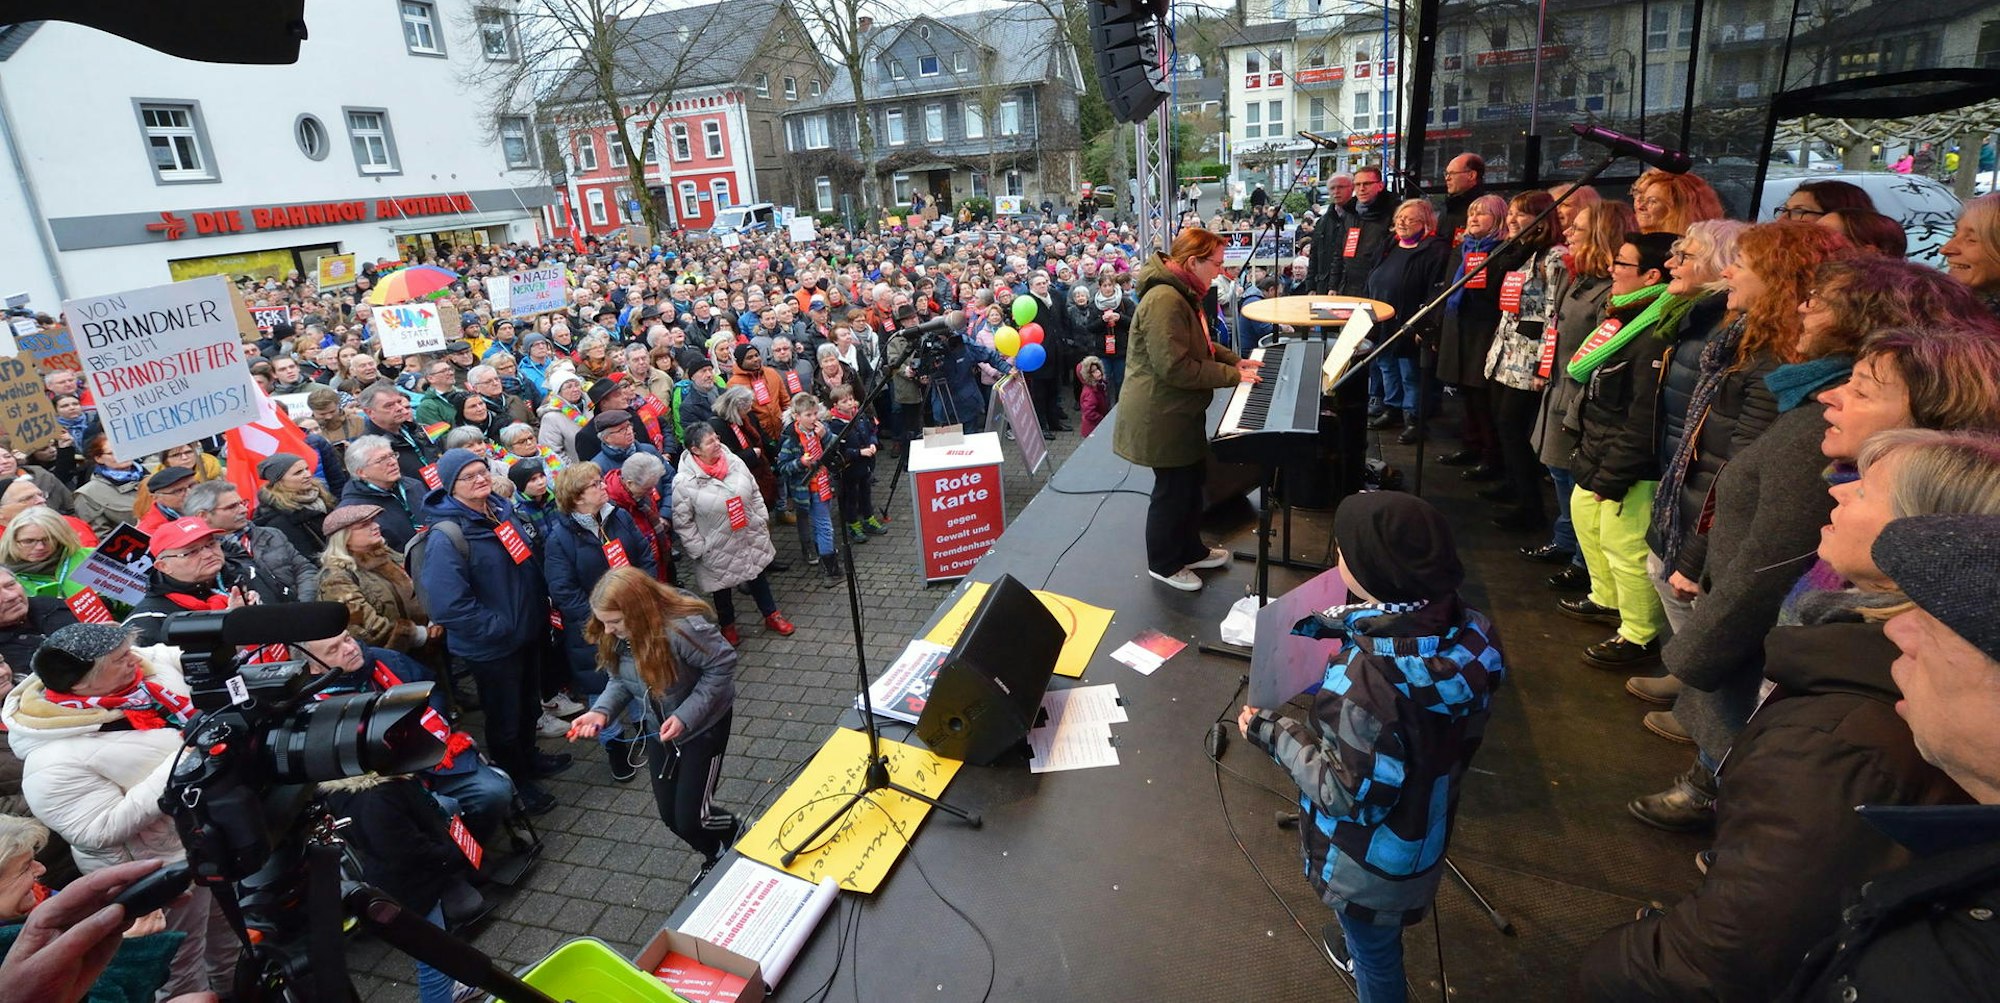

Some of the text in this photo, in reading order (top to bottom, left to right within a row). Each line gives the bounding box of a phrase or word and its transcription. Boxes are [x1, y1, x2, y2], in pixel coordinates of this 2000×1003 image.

[192, 194, 475, 234] DIE BAHNHOF APOTHEKE
[523, 268, 559, 284] NAZIS
[512, 281, 546, 295] NERVEN
[78, 296, 127, 321] VON
[255, 310, 280, 320] FCK
[82, 300, 221, 349] BRANDNER
[400, 329, 431, 340] STATT
[88, 337, 158, 371] BIS ZUM
[416, 338, 439, 349] BRAUN
[92, 342, 238, 398] BRANDSTIFTER
[133, 386, 170, 409] NUR
[169, 377, 190, 396] EIN
[935, 471, 982, 494] Rote
[931, 488, 989, 513] Karte
[947, 513, 977, 528] gegen
[936, 523, 991, 544] Gewalt und
[933, 538, 996, 560] Fremdenhass
[940, 556, 982, 572] in Overa
[72, 591, 91, 608] Rote
[75, 596, 97, 614] Karte
[762, 878, 780, 900] Demo
